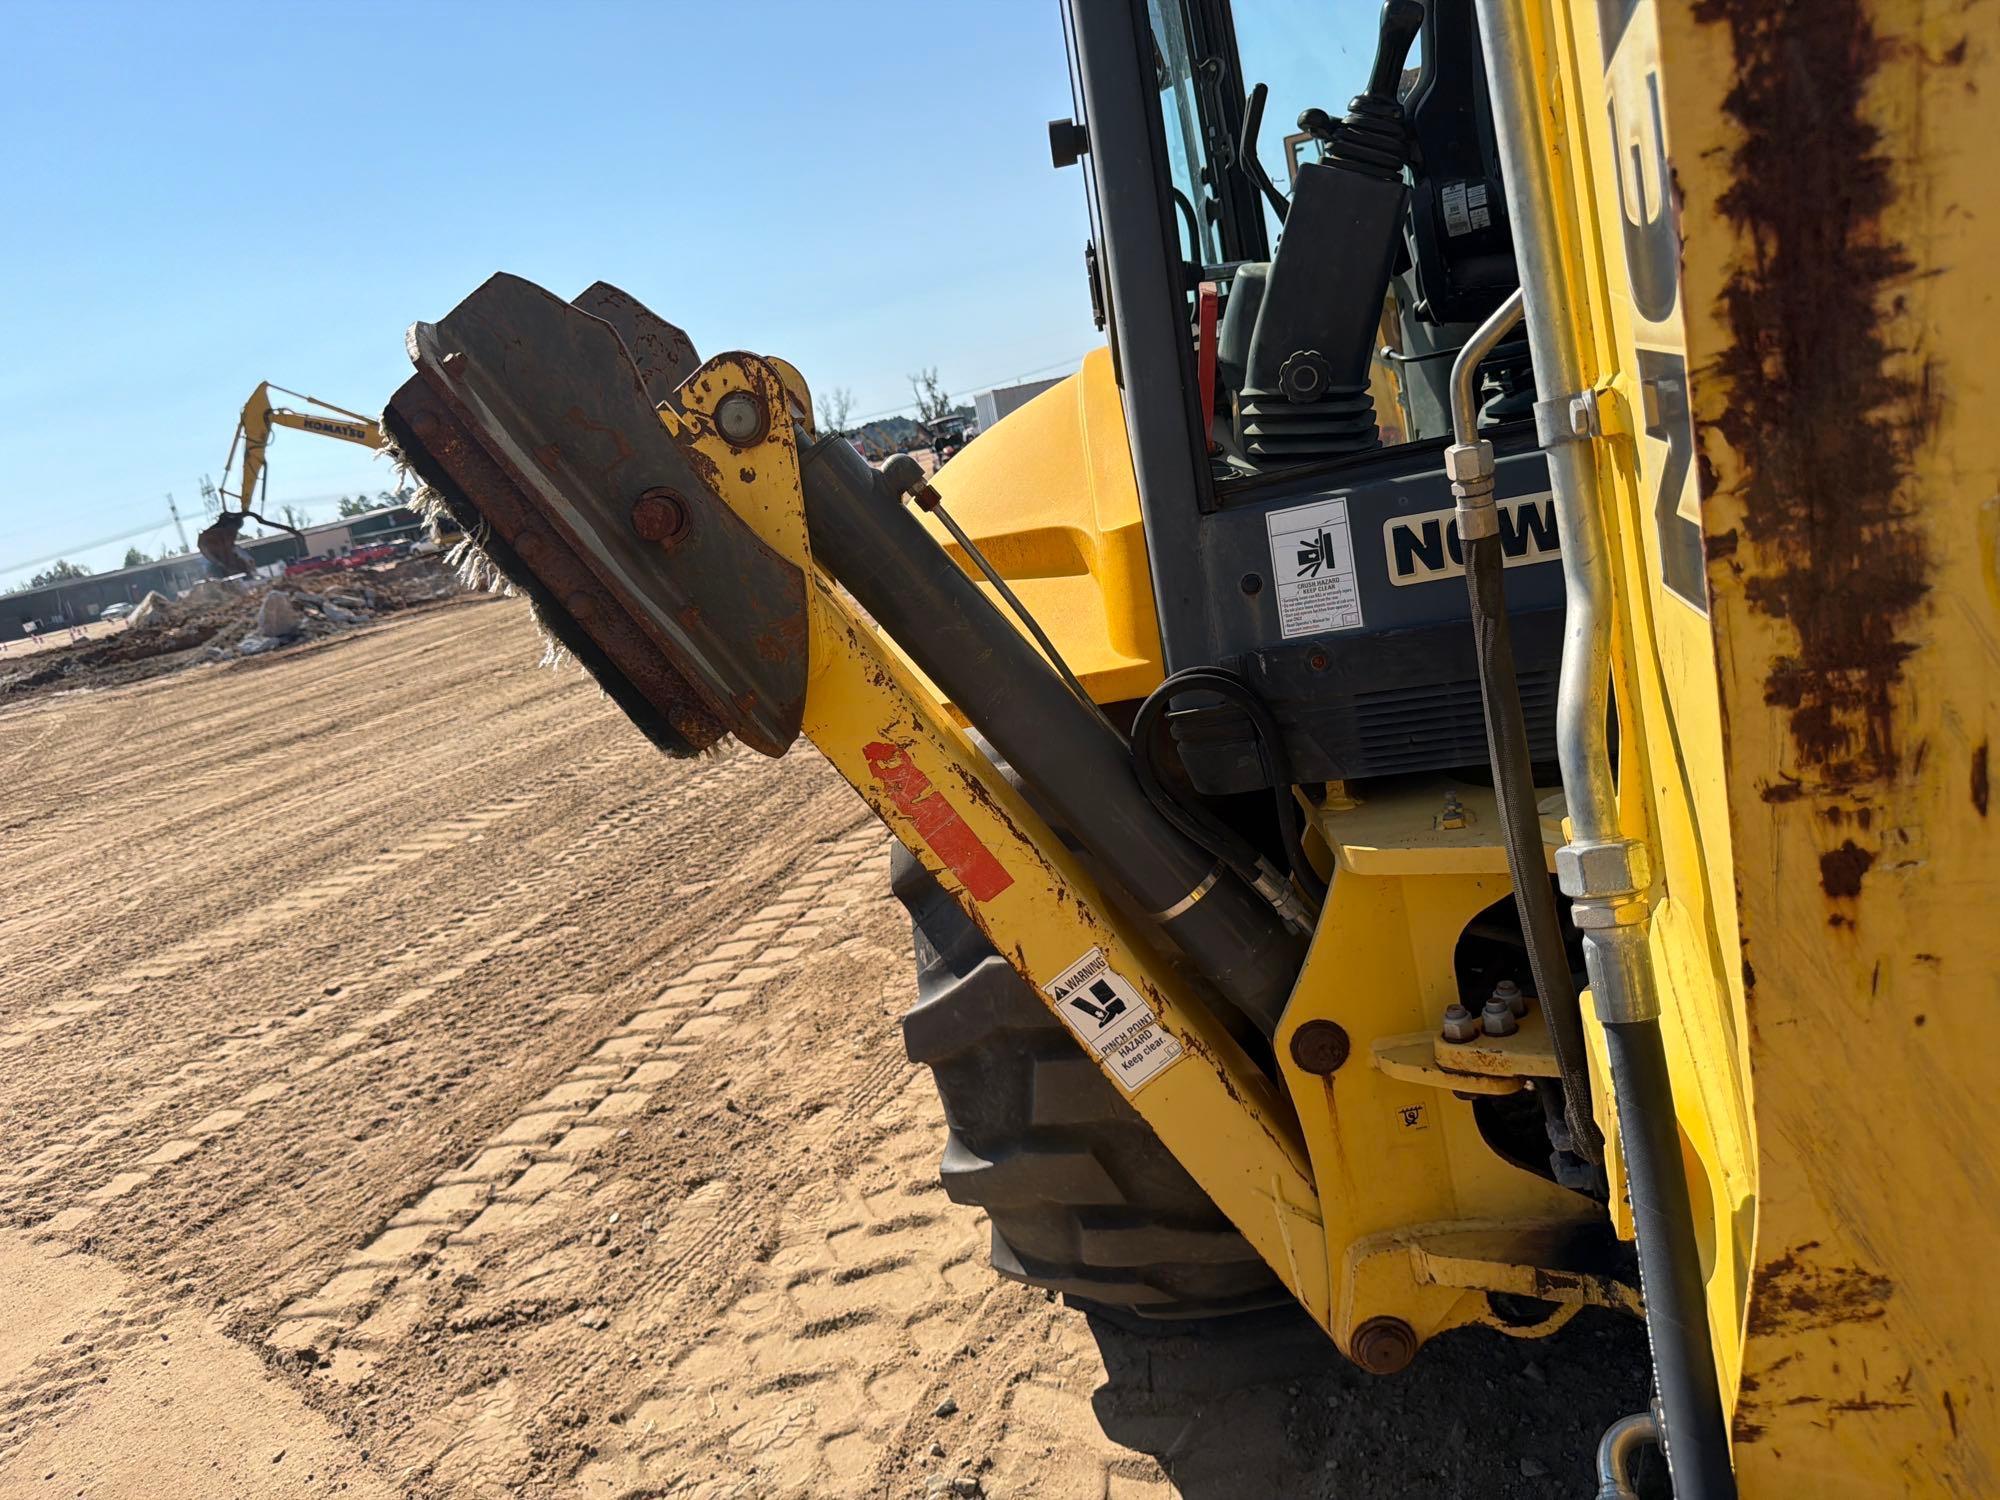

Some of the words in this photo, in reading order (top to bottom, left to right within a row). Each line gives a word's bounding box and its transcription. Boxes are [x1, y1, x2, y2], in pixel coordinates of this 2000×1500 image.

[304, 420, 365, 439] KOMATSU
[1316, 577, 1339, 586] HAZARD
[1065, 956, 1106, 990] WARNING
[1101, 1032, 1127, 1054] PINCH
[1126, 1013, 1153, 1037] POINT
[1118, 1030, 1153, 1058] HAZARD
[1121, 1056, 1144, 1071] Keep
[1144, 1037, 1167, 1056] clear.
